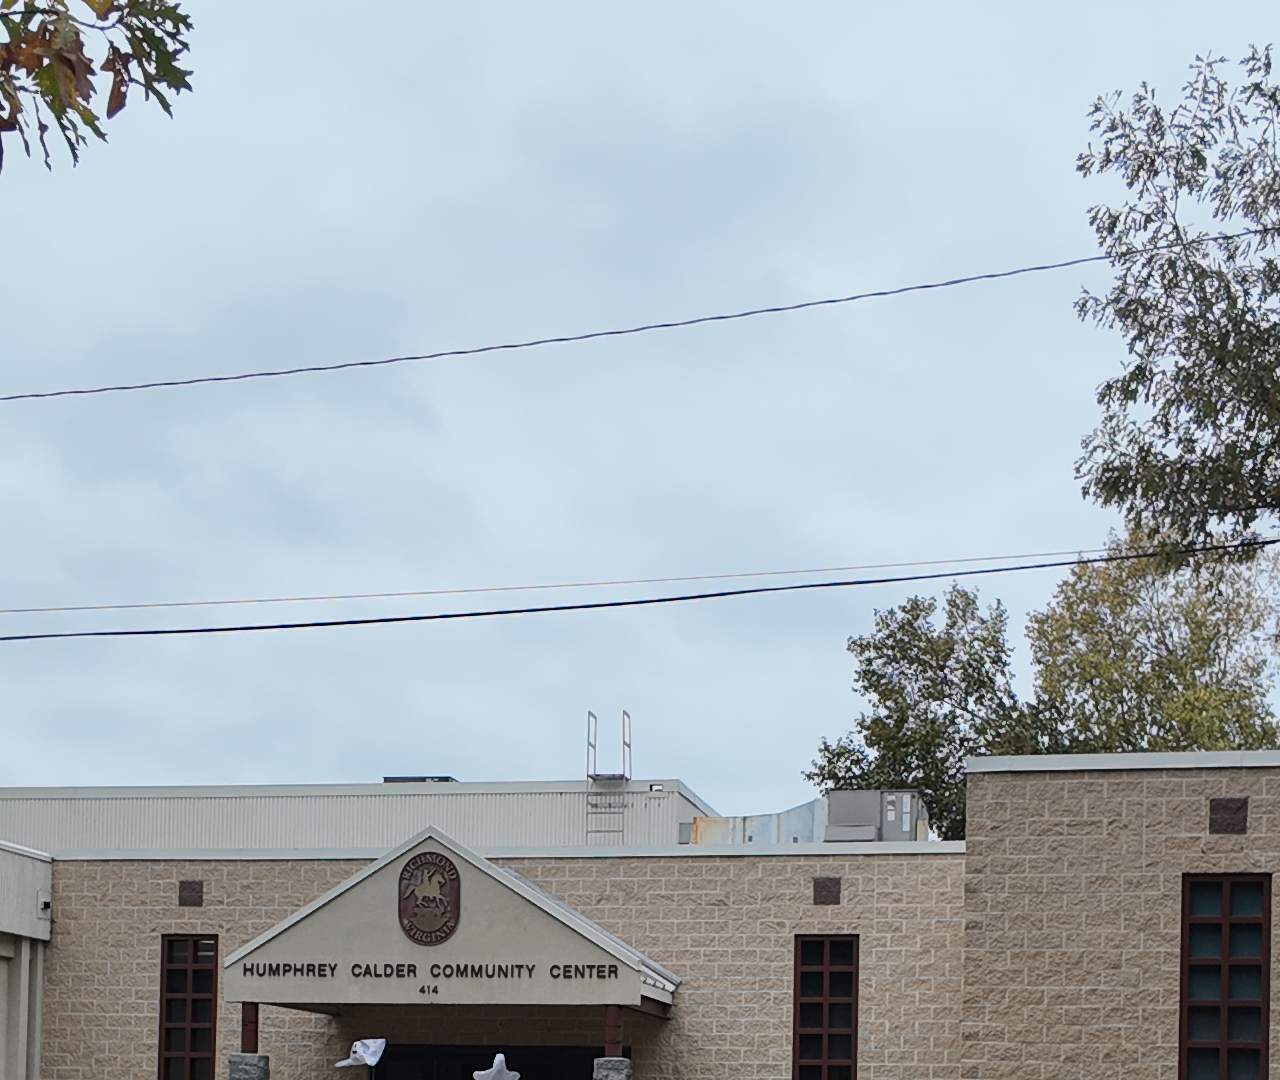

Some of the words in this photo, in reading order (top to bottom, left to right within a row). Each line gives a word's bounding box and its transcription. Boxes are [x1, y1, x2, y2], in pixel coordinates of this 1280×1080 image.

[402, 854, 457, 880] RICHMOND
[404, 919, 457, 942] VIRGINIA
[242, 962, 338, 978] HUMPHREY
[351, 963, 418, 978] CALDER
[429, 963, 536, 979] COMMUNITY
[549, 964, 619, 979] CENTER
[419, 985, 439, 995] 414
